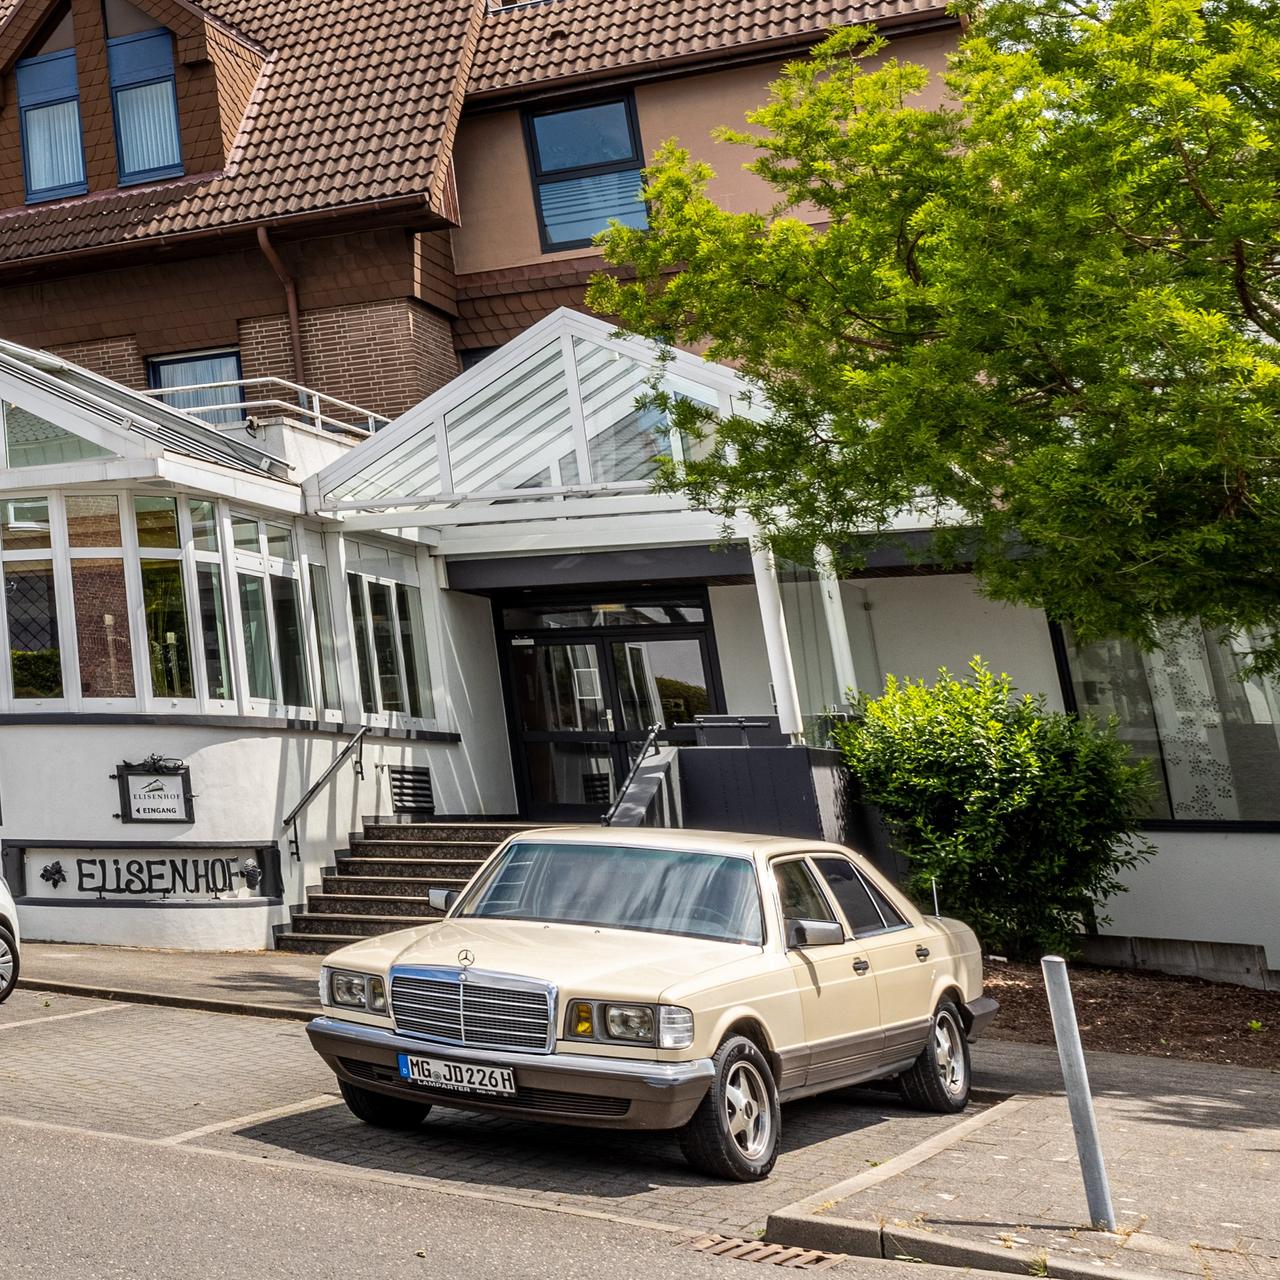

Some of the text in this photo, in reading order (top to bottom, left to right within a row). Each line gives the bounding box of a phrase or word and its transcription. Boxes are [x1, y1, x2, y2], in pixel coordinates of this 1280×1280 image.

[133, 793, 182, 801] ELISENHOF
[409, 1058, 432, 1079] MG
[417, 1079, 471, 1093] LAMPARTER
